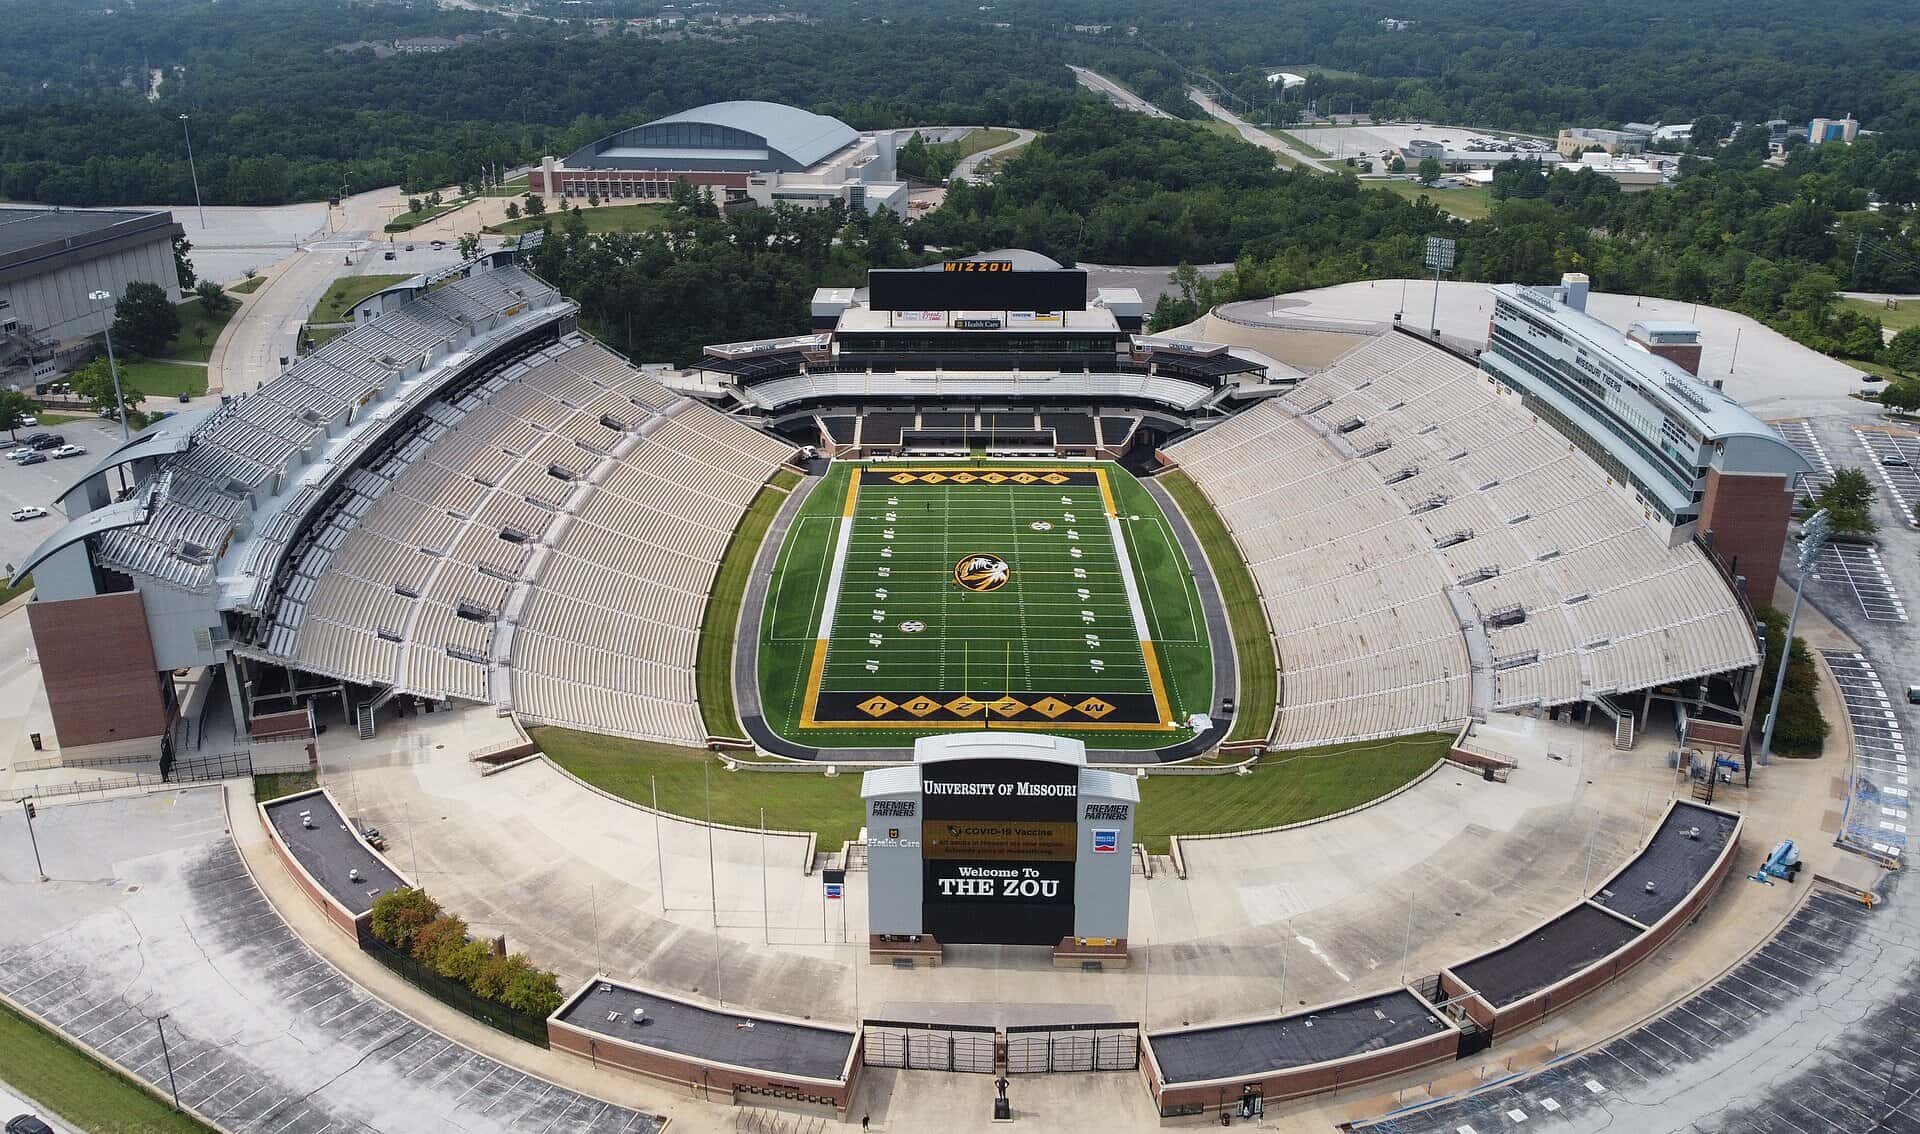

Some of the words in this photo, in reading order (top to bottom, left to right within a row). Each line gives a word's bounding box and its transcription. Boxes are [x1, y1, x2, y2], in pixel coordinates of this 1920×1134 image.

[944, 262, 1012, 272] MIZZOU
[964, 320, 984, 328] Health
[984, 320, 1000, 328] Care
[1575, 354, 1602, 378] MISSOURI
[1602, 373, 1622, 393] TIGERS
[875, 588, 888, 598] 40
[1077, 588, 1091, 599] 40
[872, 609, 886, 621] 30
[1081, 610, 1096, 622] 30
[869, 632, 883, 645] 20
[1085, 633, 1100, 647] 20
[865, 659, 880, 671] 10
[1090, 659, 1105, 671] 10
[872, 800, 915, 810] PREMIER
[1086, 804, 1129, 814] PREMIER
[871, 809, 915, 817] PARTNERS
[1084, 812, 1128, 821] PARTNERS
[964, 827, 1011, 836] COVID-19
[1015, 829, 1053, 837] Vaccine
[867, 838, 897, 848] Health
[899, 839, 920, 848] Care
[958, 867, 1019, 878] Welcome
[1022, 868, 1040, 878] To
[938, 878, 994, 896] THE
[1002, 879, 1060, 897] ZOU
